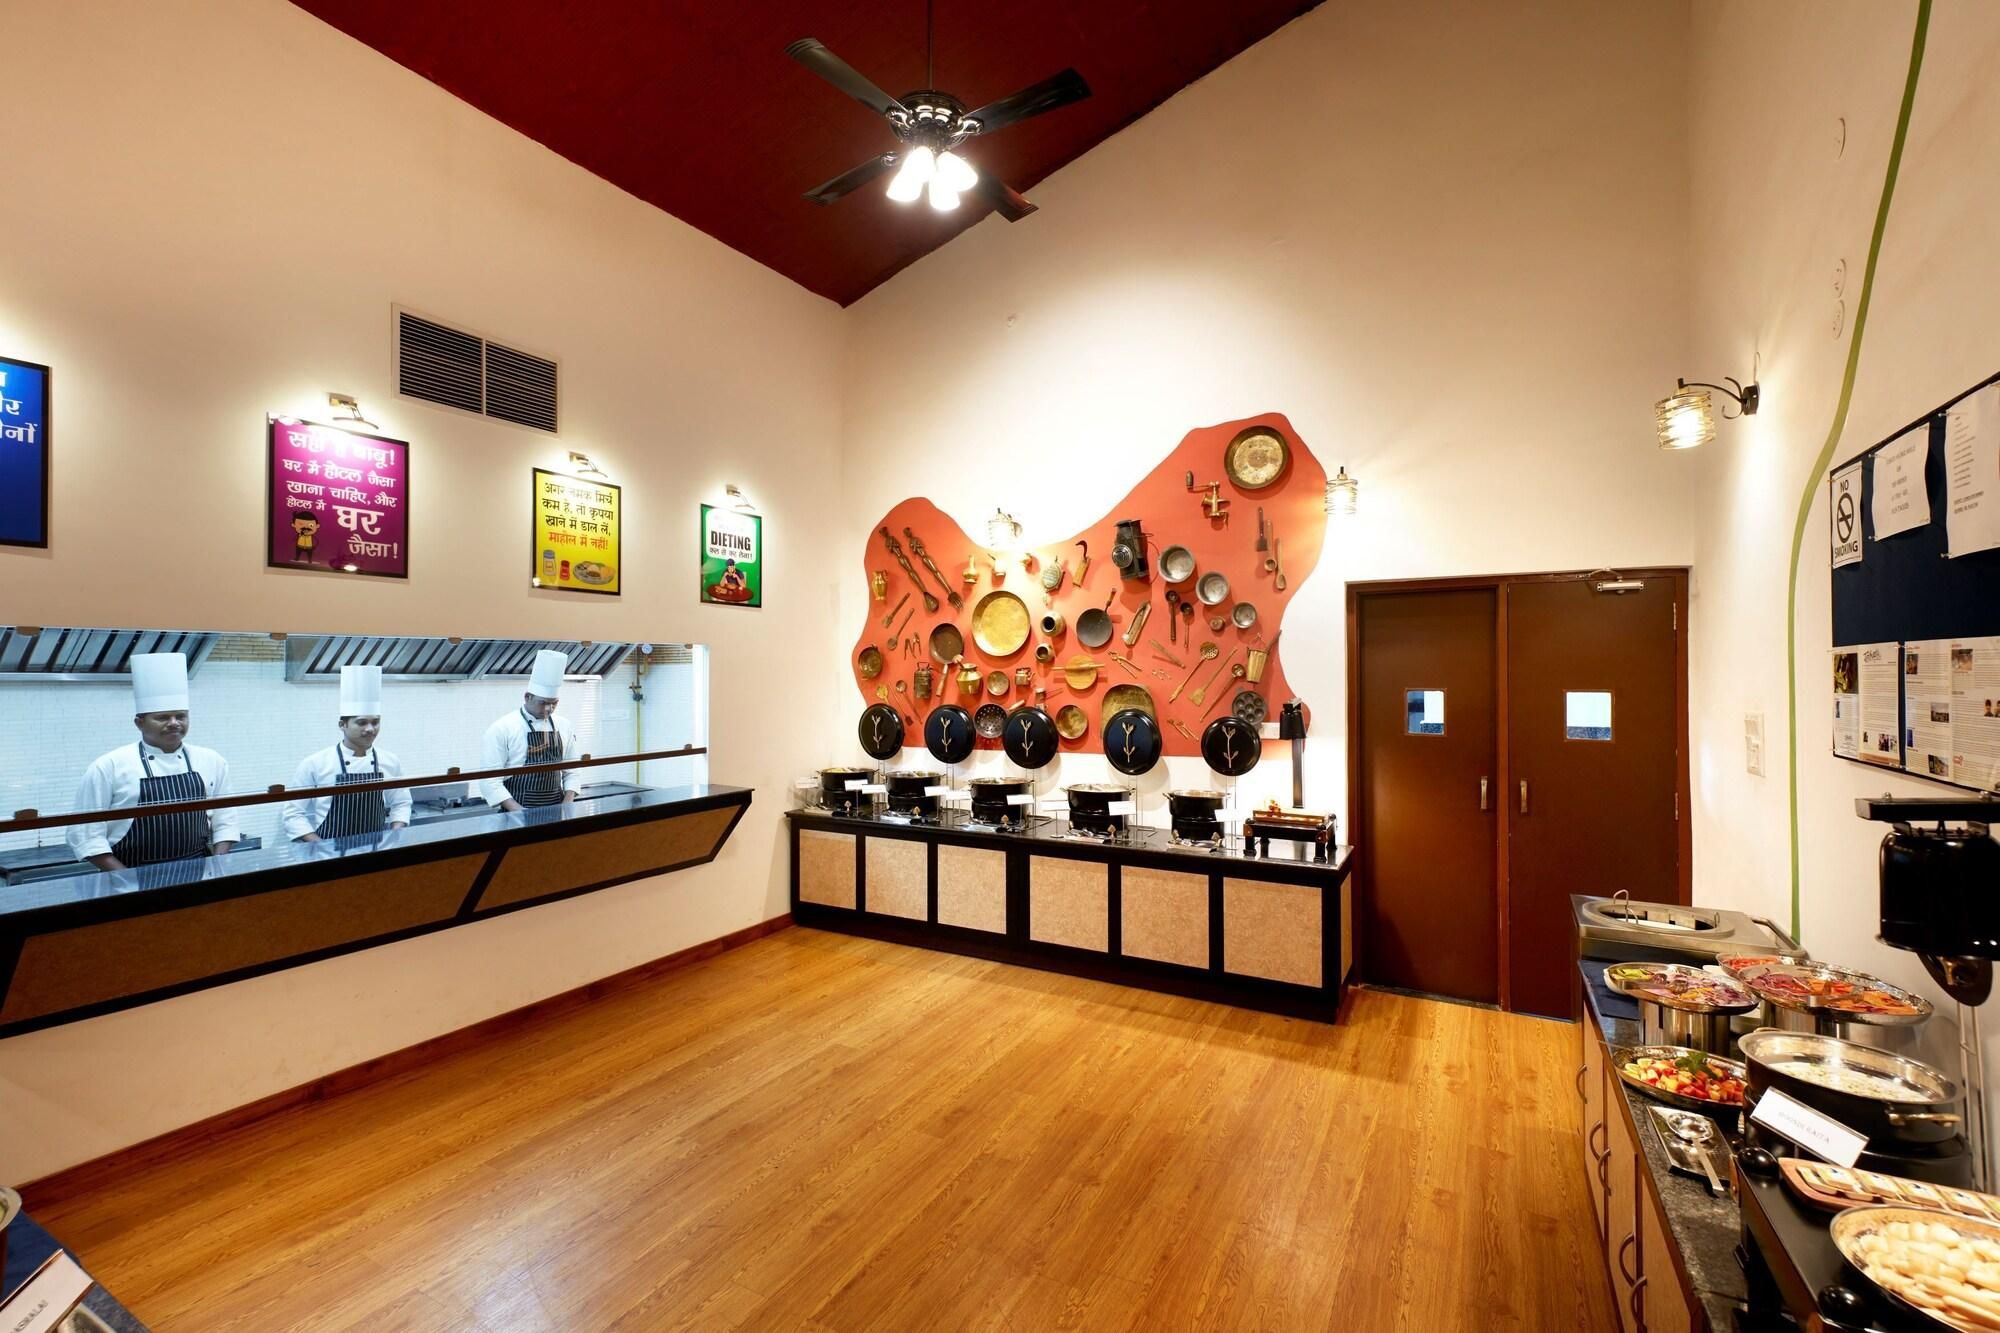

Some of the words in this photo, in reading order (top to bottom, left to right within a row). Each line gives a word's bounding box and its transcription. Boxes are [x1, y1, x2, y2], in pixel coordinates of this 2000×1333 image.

[282, 459, 303, 473] घर
[323, 462, 363, 483] होटल
[367, 470, 396, 488] जैसा
[286, 480, 326, 496] खाना
[374, 492, 398, 508] और
[544, 482, 566, 495] अगर
[1840, 479, 1849, 493] NO
[286, 495, 313, 510] होटल
[332, 504, 385, 536] घर
[542, 498, 560, 511] कम
[589, 506, 614, 521] कृपया
[545, 514, 566, 528] खाने
[580, 520, 598, 533] डाल
[347, 533, 399, 559] जैसा!
[711, 530, 751, 552] DIETING
[1834, 540, 1859, 559] SMOKING
